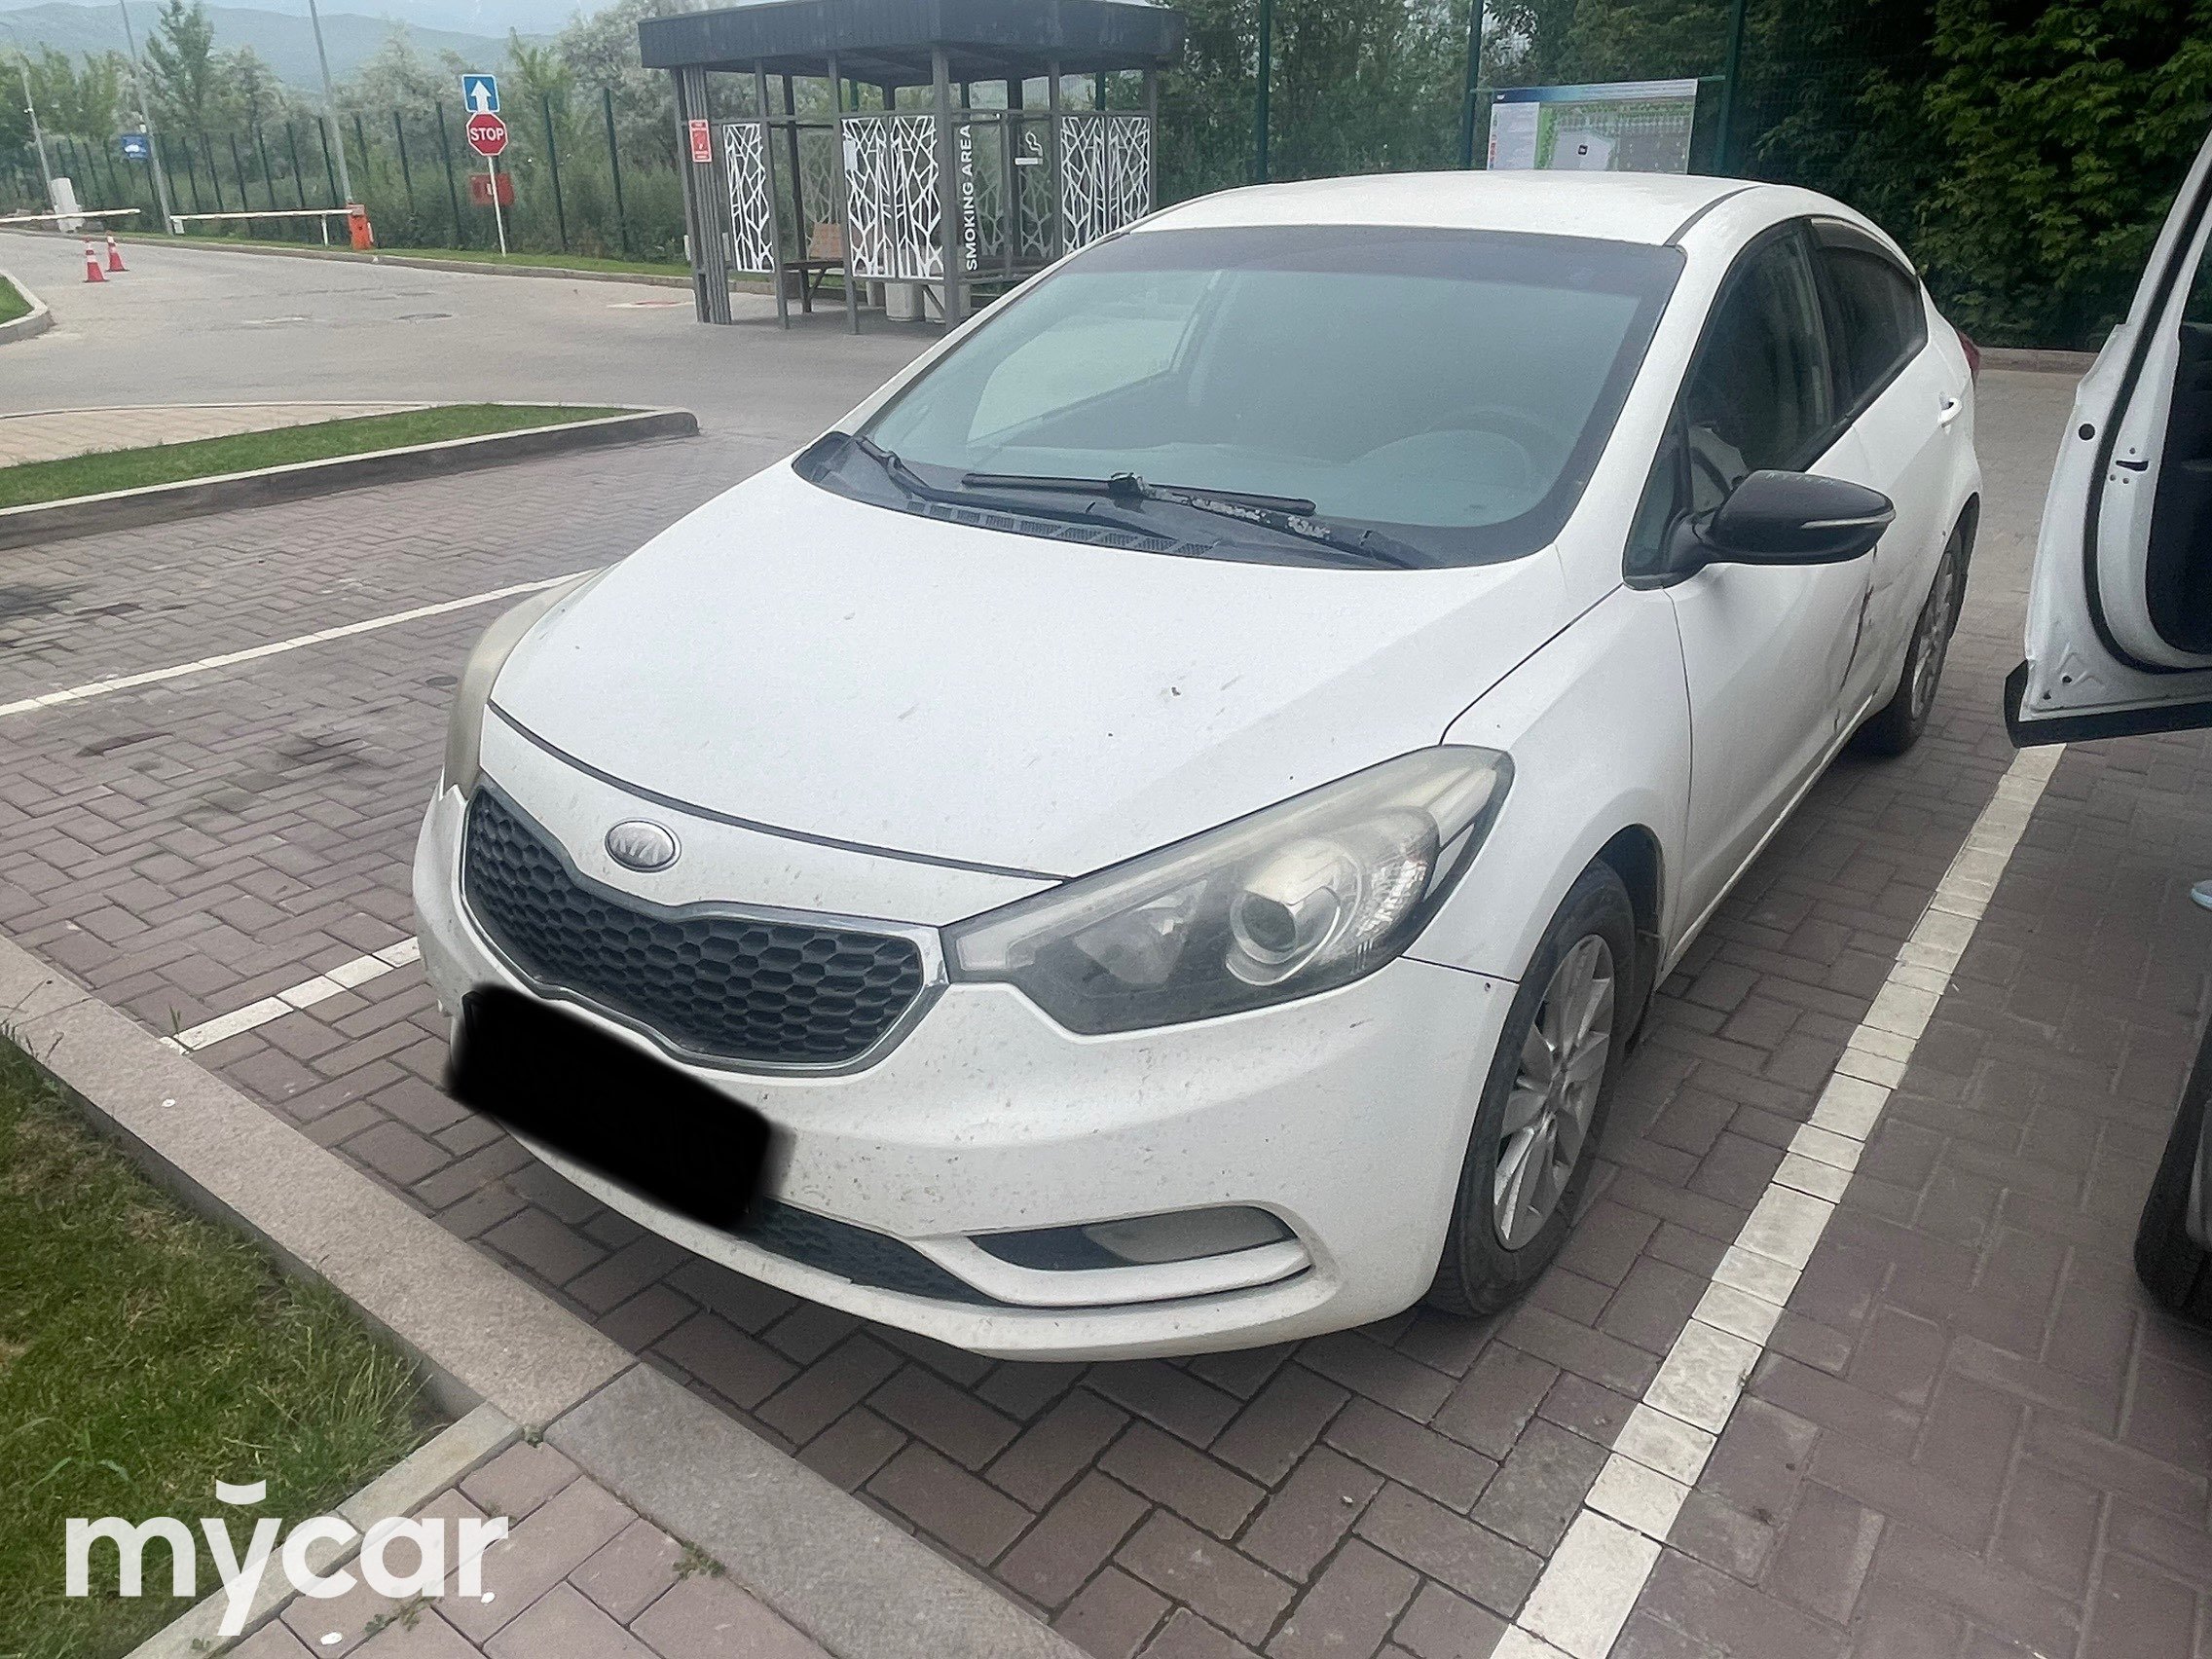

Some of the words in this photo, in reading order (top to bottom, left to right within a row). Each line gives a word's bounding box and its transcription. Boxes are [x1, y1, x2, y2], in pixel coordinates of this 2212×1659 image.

[469, 127, 504, 141] STOP
[959, 125, 973, 177] AREA
[962, 182, 978, 271] SMOKING
